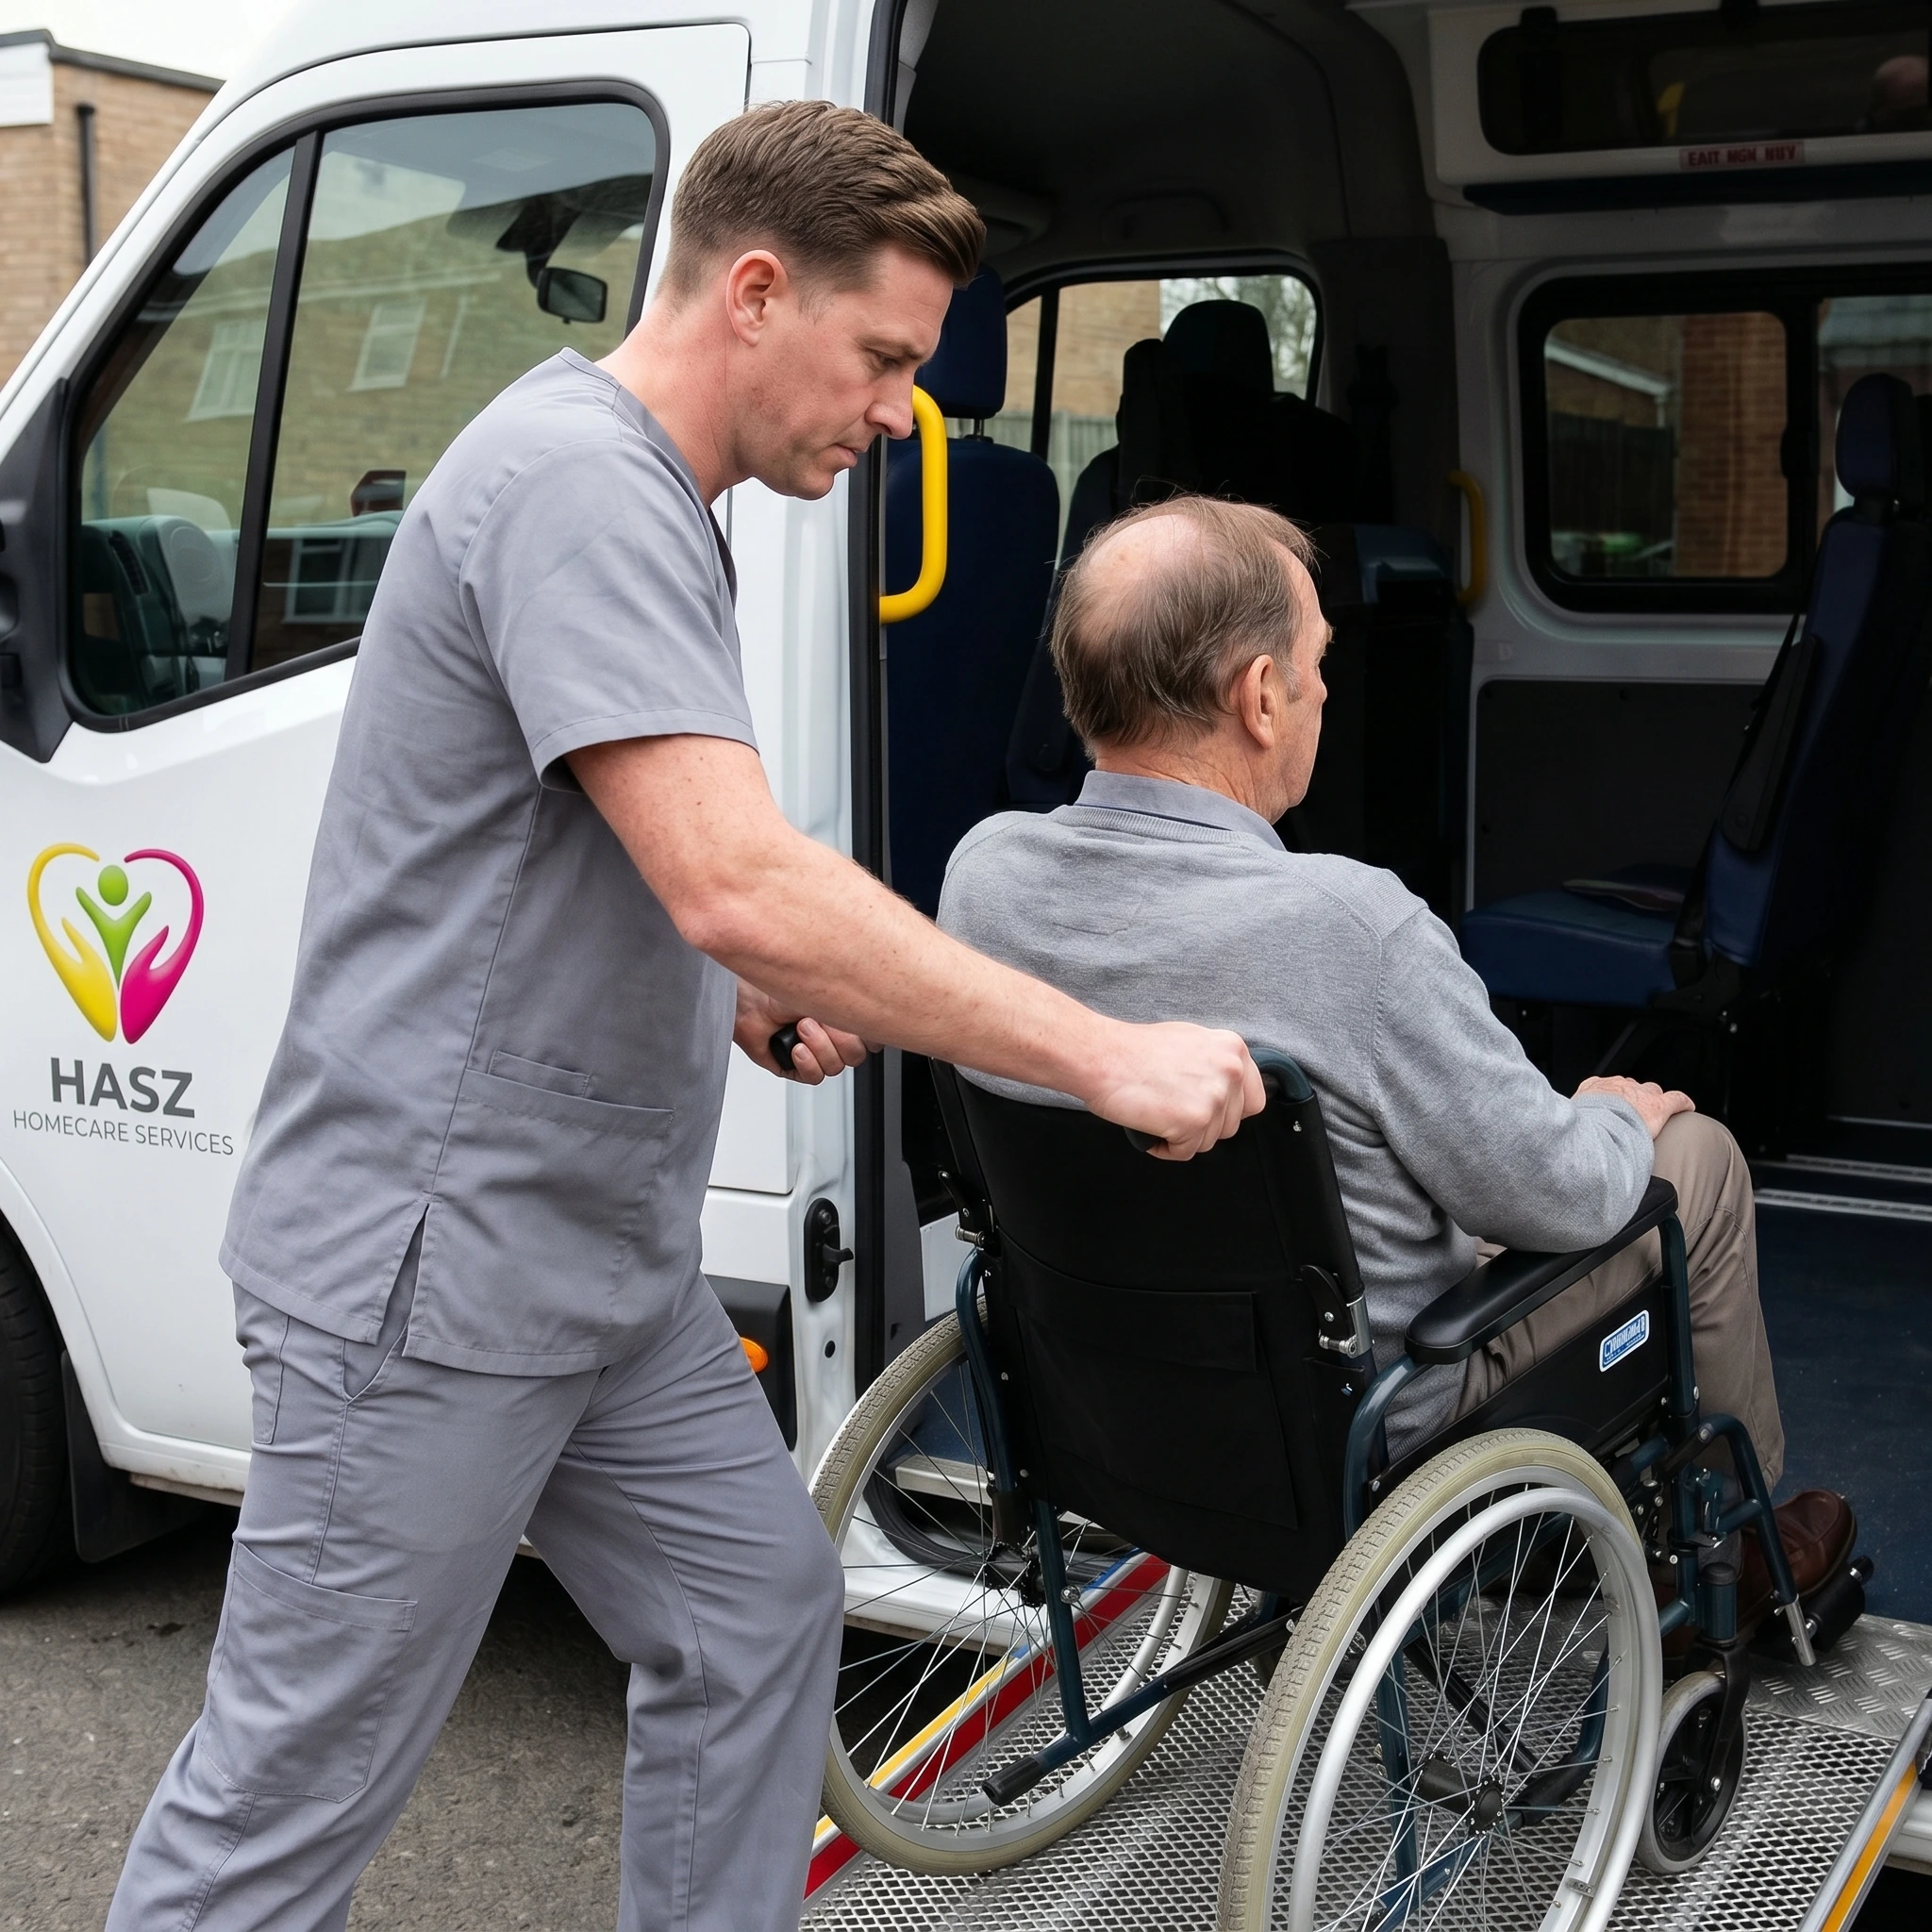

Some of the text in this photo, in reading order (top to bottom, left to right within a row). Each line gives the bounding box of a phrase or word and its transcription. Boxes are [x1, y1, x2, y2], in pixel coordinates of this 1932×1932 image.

[51, 1058, 194, 1118] HASZ
[13, 1109, 234, 1156] HOMECARE SERVICES
